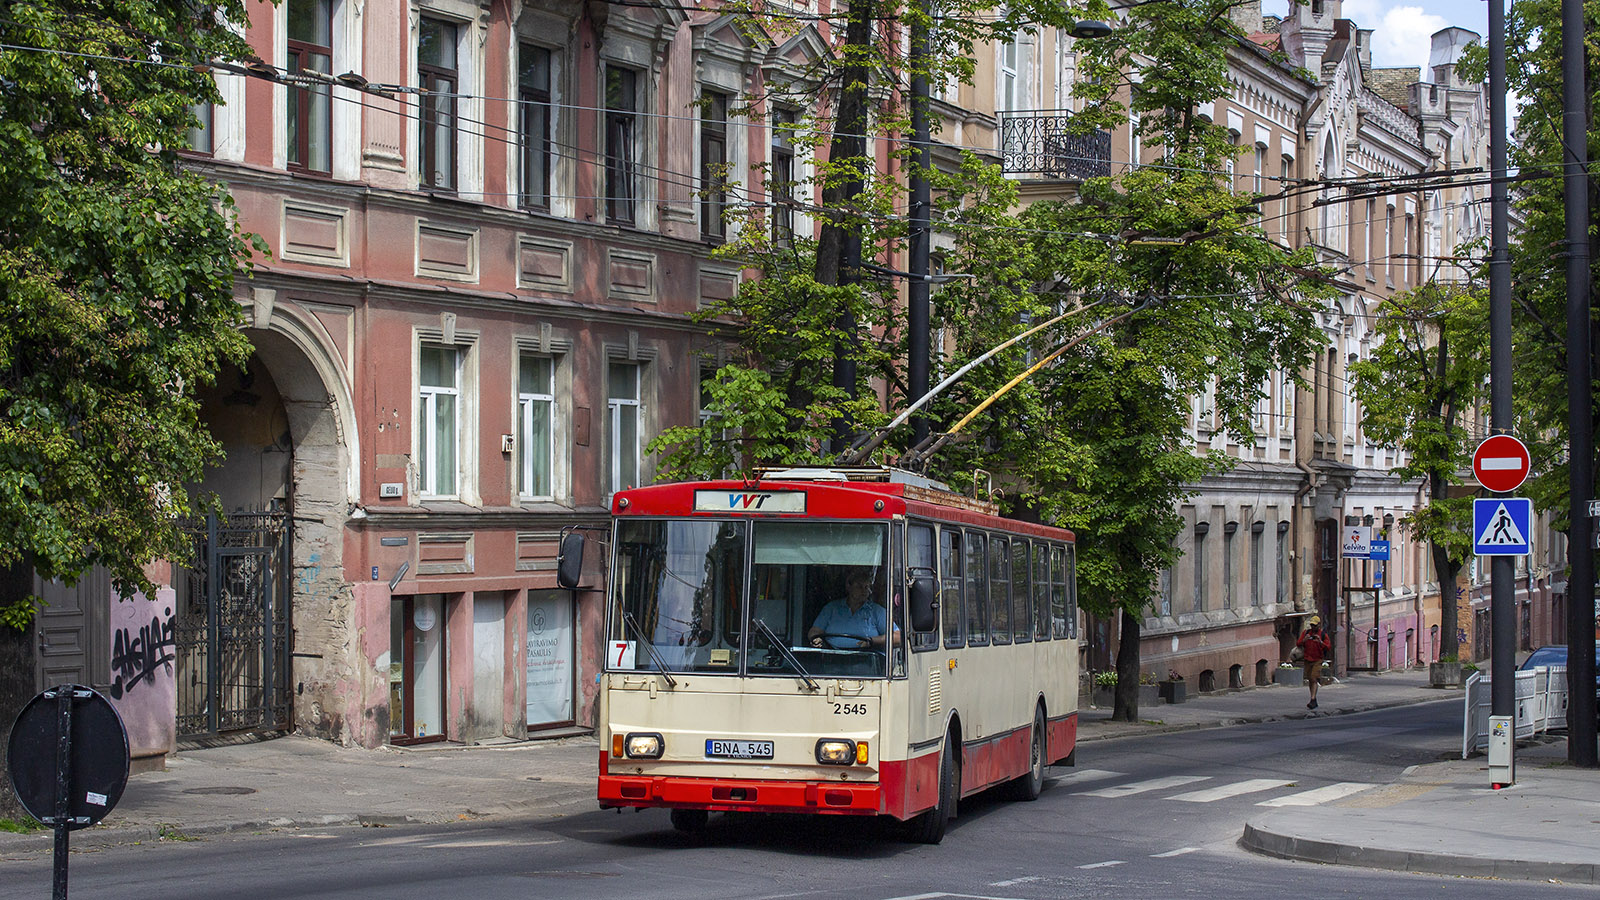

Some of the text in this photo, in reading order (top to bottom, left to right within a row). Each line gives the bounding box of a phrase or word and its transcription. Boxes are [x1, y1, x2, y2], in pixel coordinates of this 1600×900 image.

[729, 494, 772, 509] VVT
[1343, 543, 1366, 551] Kelvita
[616, 643, 628, 667] 7
[714, 742, 740, 754] BNA
[748, 743, 771, 755] 545
